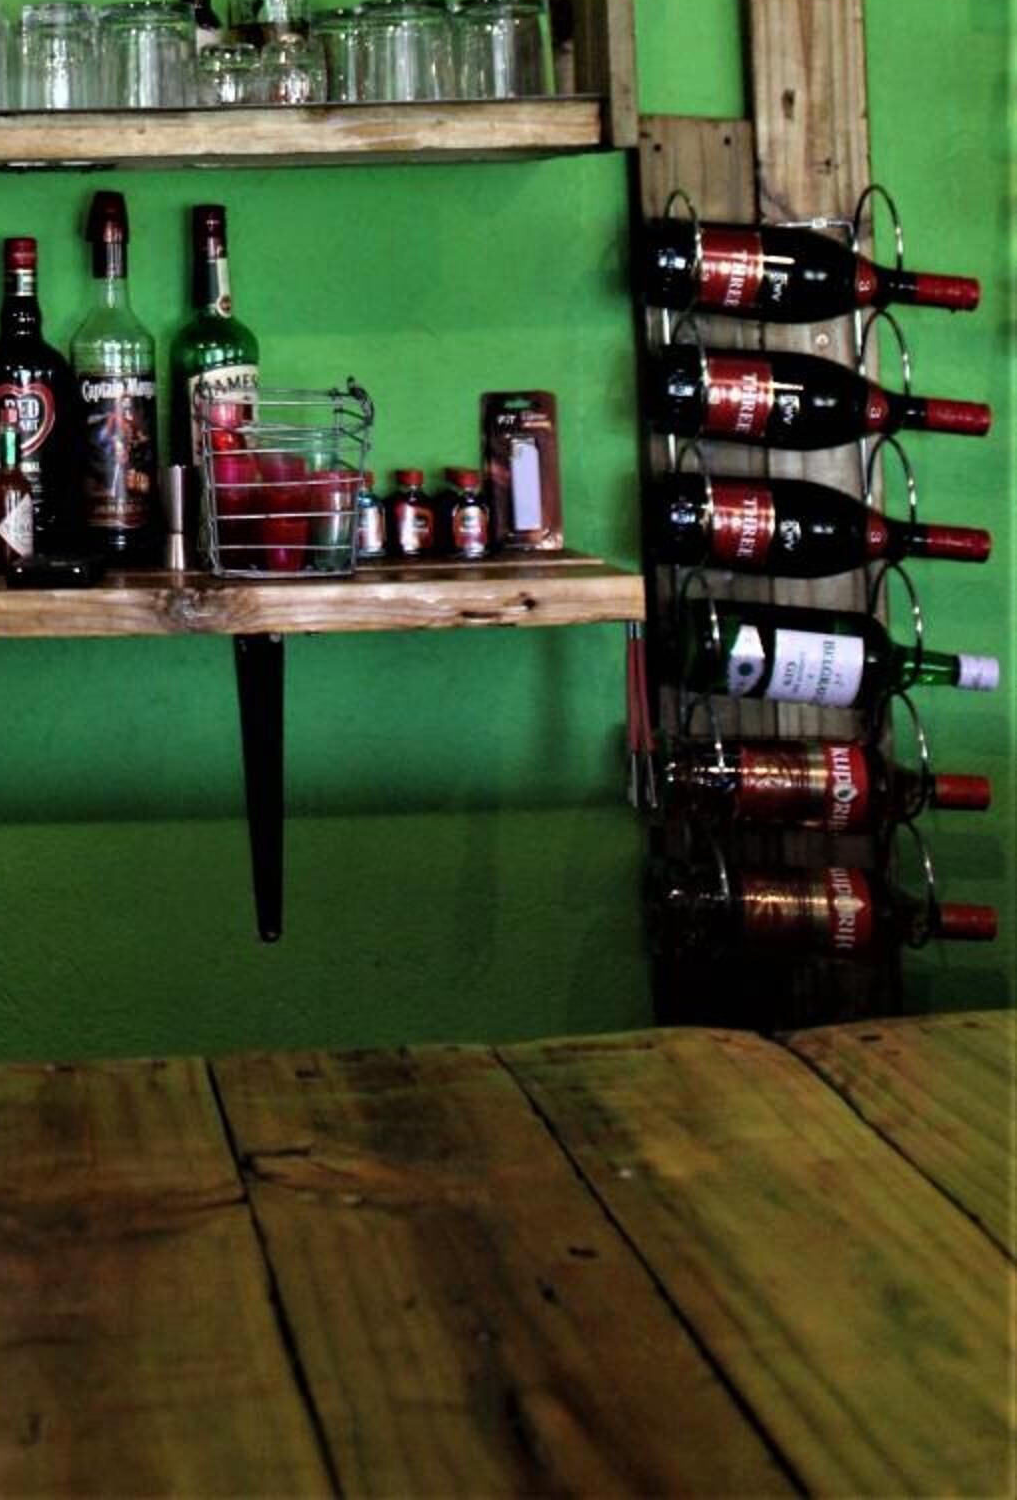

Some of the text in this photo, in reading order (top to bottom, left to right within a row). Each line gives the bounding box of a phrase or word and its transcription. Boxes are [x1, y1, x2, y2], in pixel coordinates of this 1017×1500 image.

[725, 248, 749, 307] THREE
[858, 279, 872, 293] 3
[82, 381, 125, 403] Captain
[735, 372, 759, 432] THREE
[869, 405, 884, 420] 3
[735, 497, 759, 558] THREE
[869, 531, 884, 544] 3
